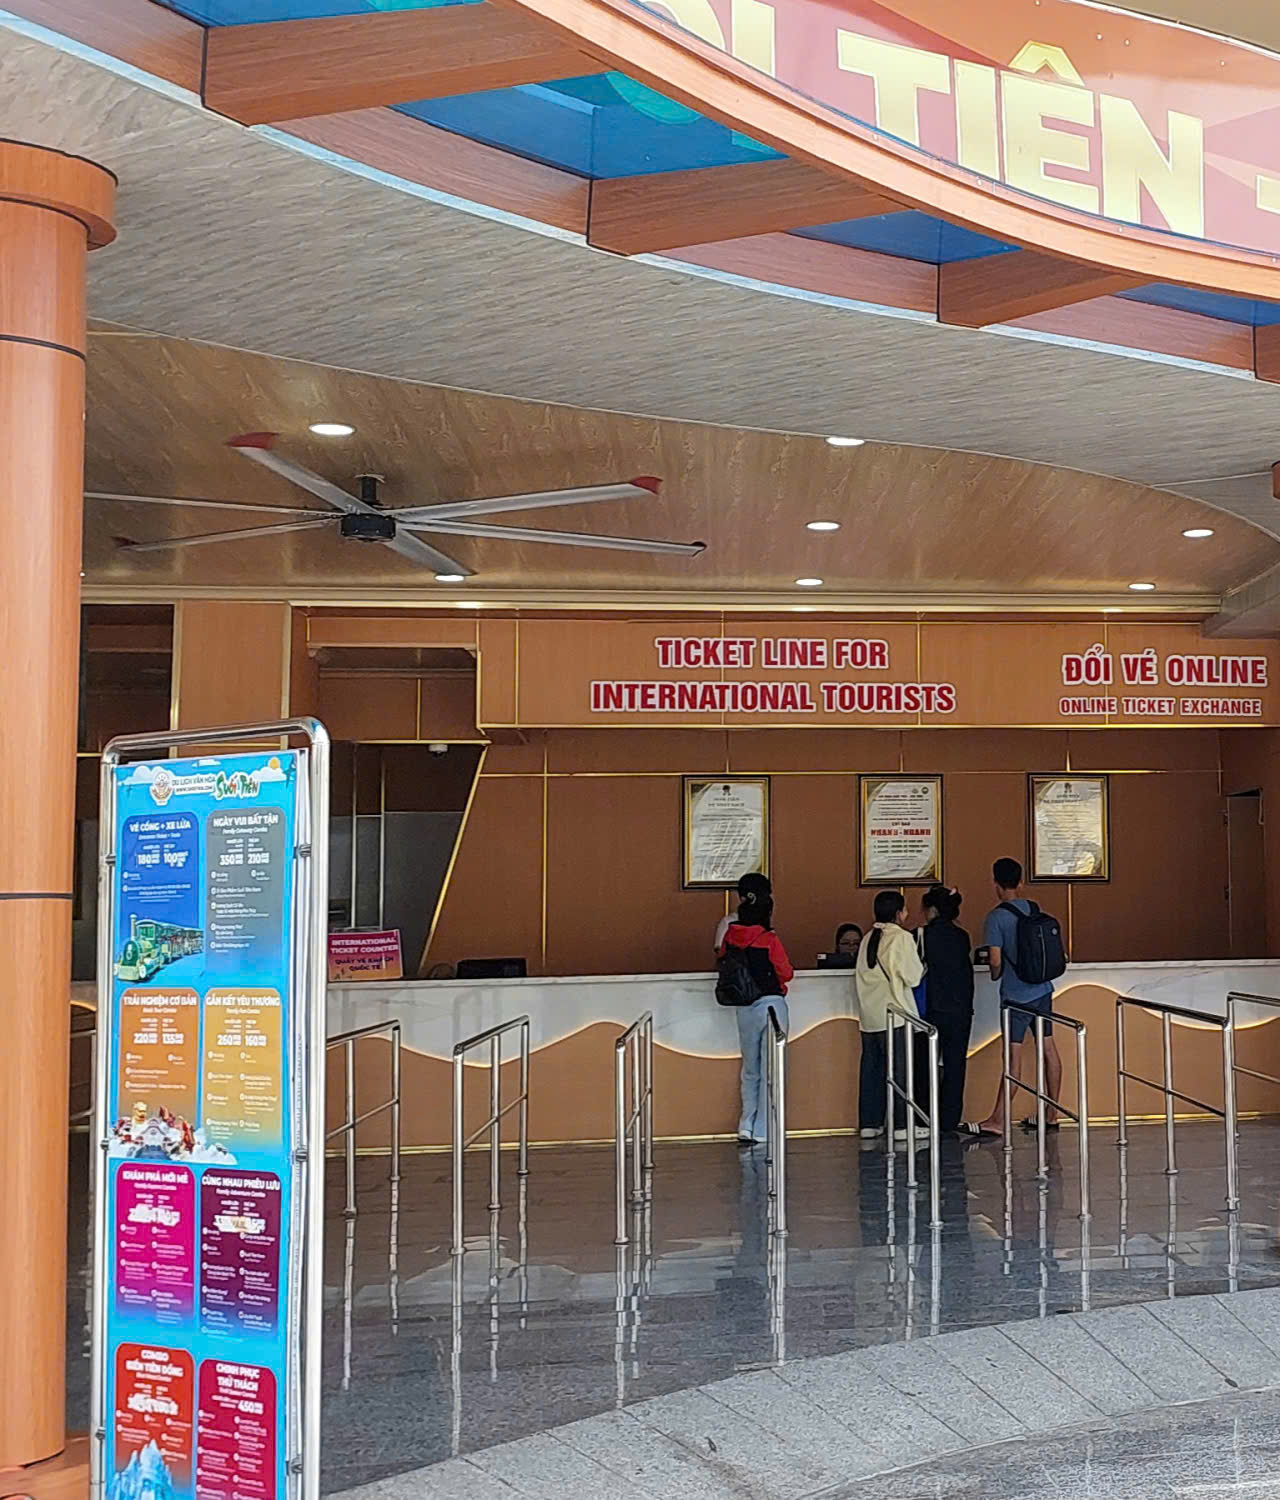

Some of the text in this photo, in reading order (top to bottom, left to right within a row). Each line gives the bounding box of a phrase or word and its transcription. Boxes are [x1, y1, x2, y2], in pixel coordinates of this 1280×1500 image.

[837, 40, 1202, 240] TIÊN
[656, 638, 889, 669] TICKET LINE FOR
[1063, 643, 1267, 687] ĐỔI VÉ ONLINE
[591, 681, 956, 713] INTERNATIONAL TOURISTS
[1060, 697, 1262, 716] ONLINE TICKET EXCHANGE
[331, 937, 397, 946] INTERNATIONAL
[360, 944, 399, 953] COUNTER
